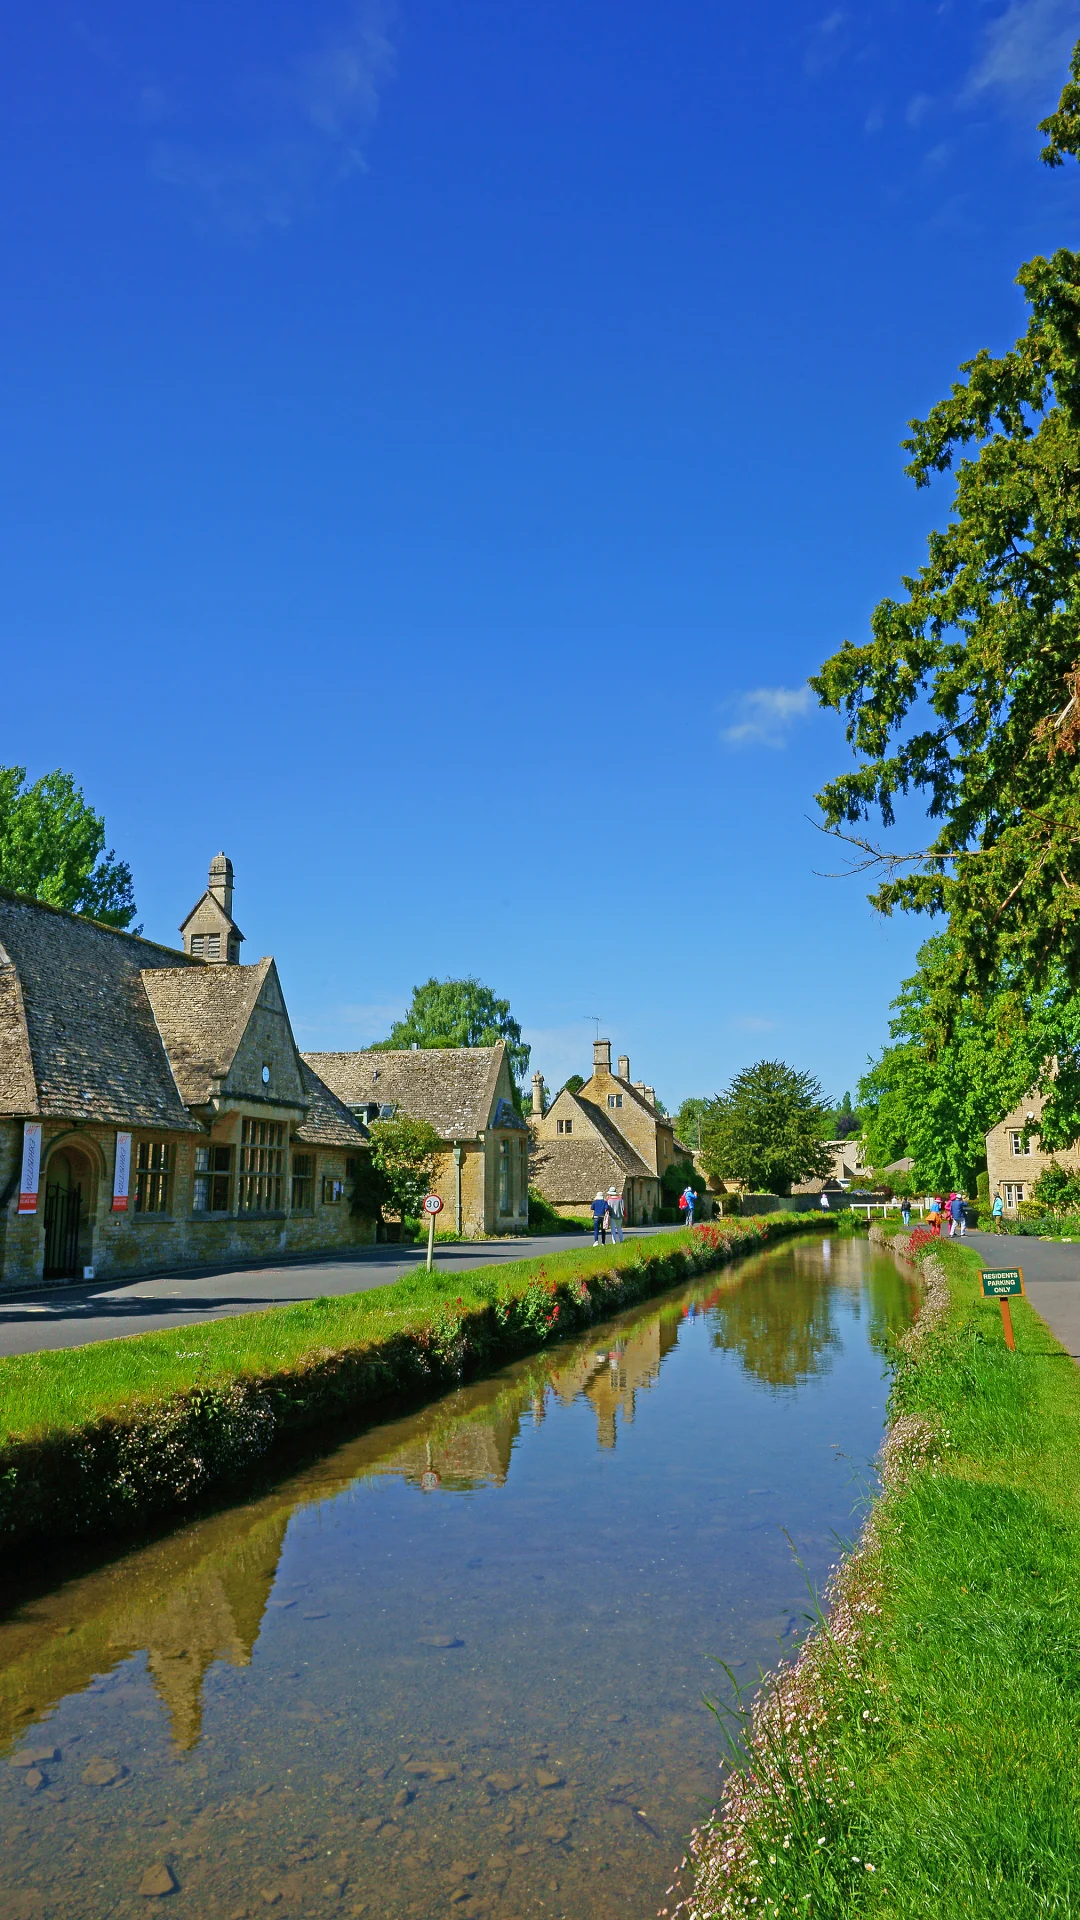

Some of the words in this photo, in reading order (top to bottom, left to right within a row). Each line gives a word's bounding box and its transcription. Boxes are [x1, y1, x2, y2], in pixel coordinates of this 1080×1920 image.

[26, 1125, 40, 1135] ART
[26, 1138, 36, 1193] EXHIBITION
[426, 1200, 440, 1208] 30
